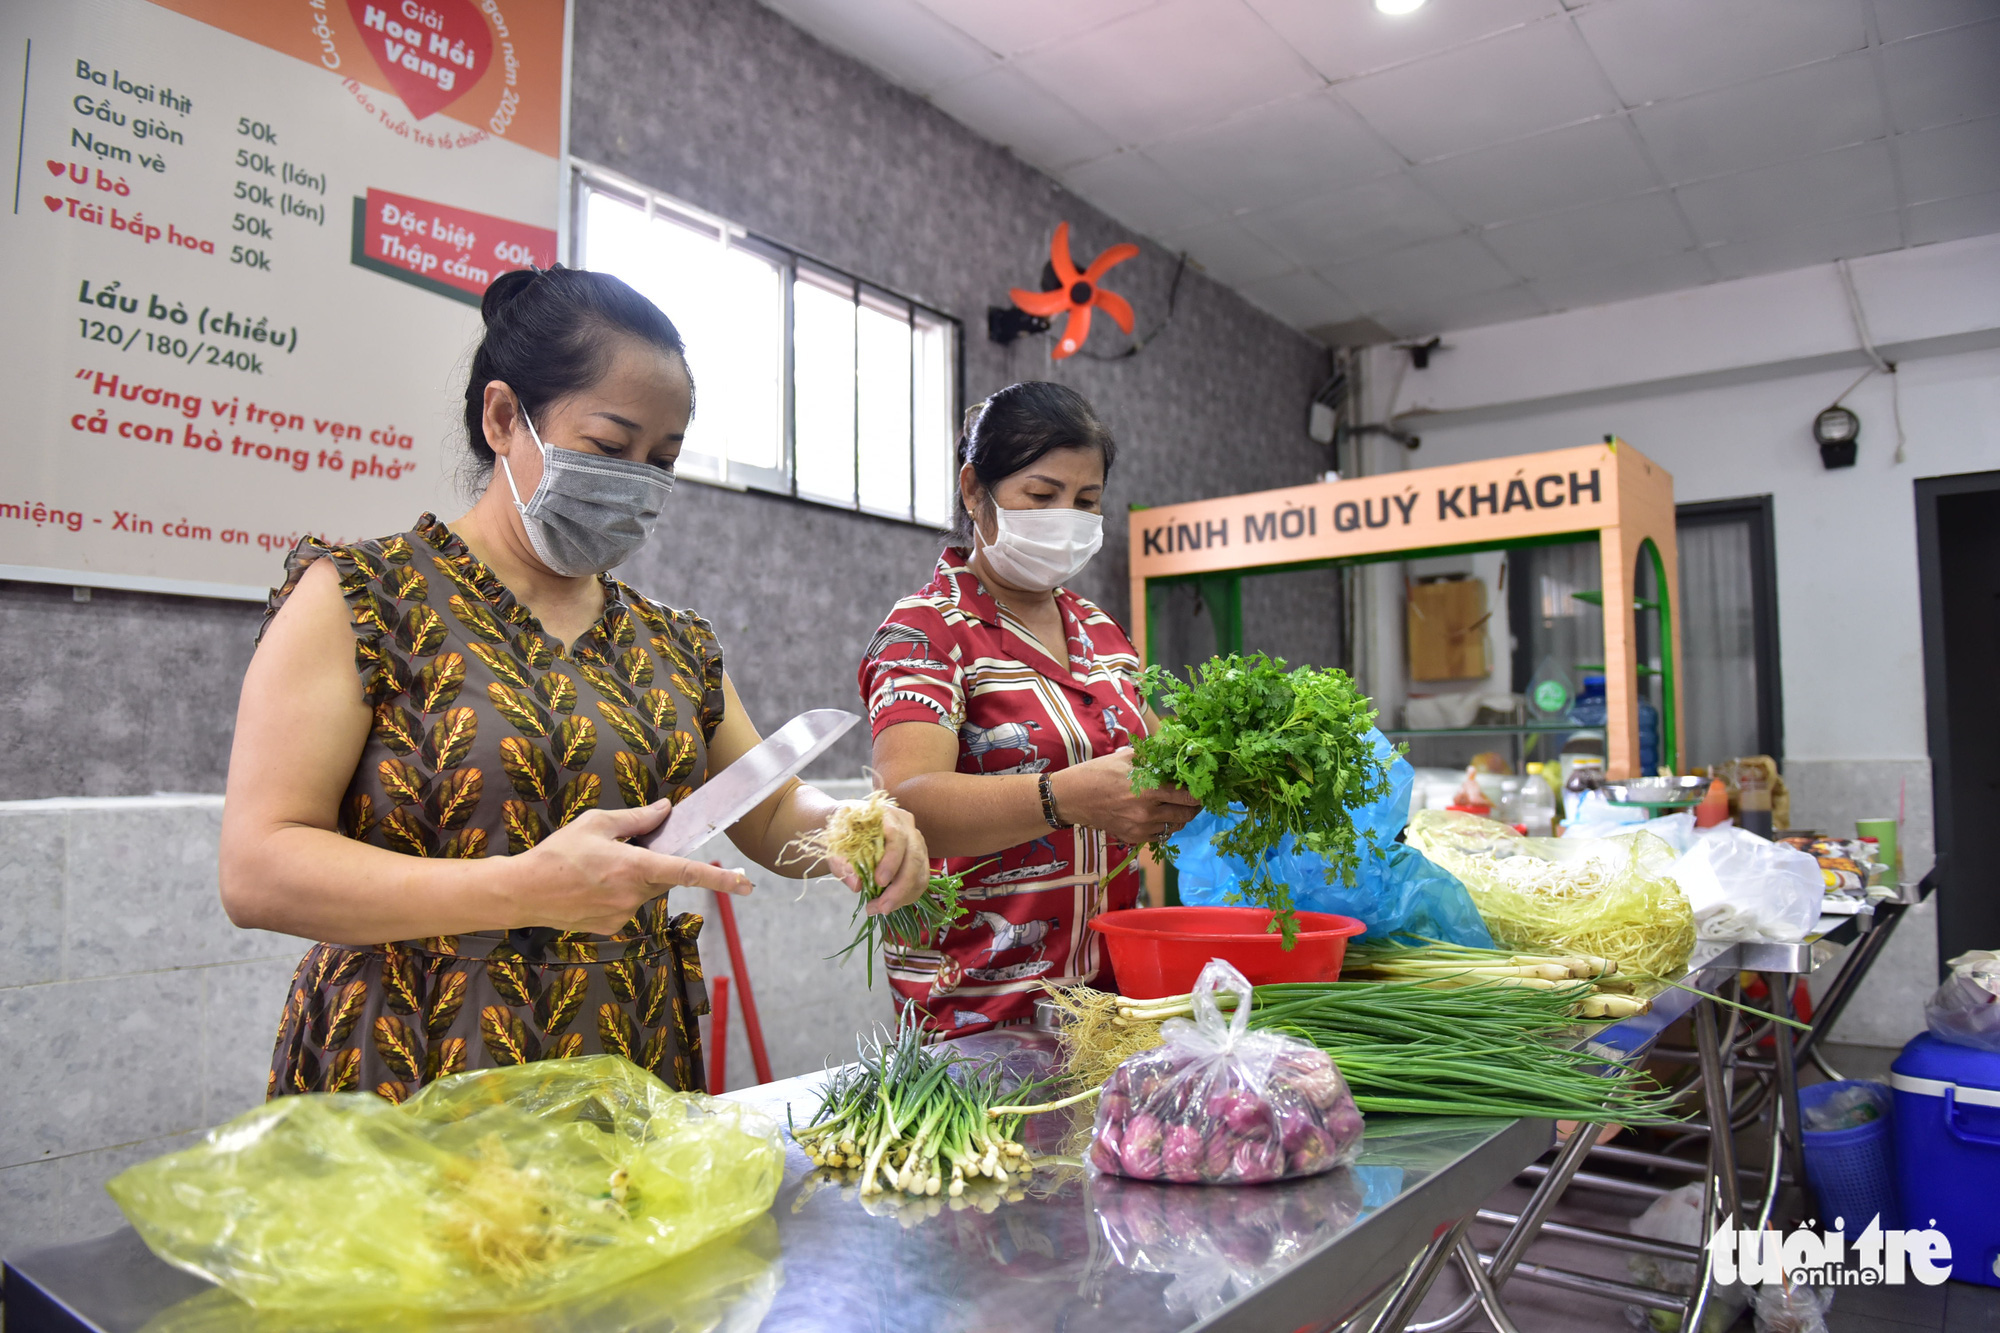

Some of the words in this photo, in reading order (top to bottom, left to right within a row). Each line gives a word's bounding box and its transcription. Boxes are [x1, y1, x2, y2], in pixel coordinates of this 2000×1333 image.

[312, 13, 340, 69] Cuộc
[363, 4, 423, 47] Hoa
[428, 31, 475, 70] Hồi
[401, 0, 444, 32] Giải
[384, 37, 456, 91] Vàng
[76, 58, 107, 87] Ba
[112, 68, 155, 104] loại
[159, 87, 193, 118] thịt
[237, 116, 278, 146] 50k
[489, 86, 519, 134] 2020
[71, 127, 132, 164] Nạm
[138, 152, 166, 174] vè
[234, 180, 275, 209] 50k
[280, 192, 325, 227] (lớn)
[73, 94, 126, 126] Gầu
[132, 118, 184, 146] giòn
[235, 148, 276, 177] 50k
[281, 161, 327, 196] (lớn)
[68, 162, 89, 185] U
[95, 168, 131, 197] bò
[232, 212, 274, 241] 50k
[65, 196, 104, 226] Tái
[109, 207, 162, 245] bắp
[167, 223, 215, 255] hoa
[230, 244, 272, 273] 50k
[380, 202, 428, 237] Đặc
[430, 216, 476, 253] biệt
[493, 240, 535, 268] 60k
[380, 233, 439, 275] Thập
[78, 279, 139, 314] Lẩu
[147, 293, 189, 326] bò
[199, 305, 298, 354] (chiều)
[78, 317, 266, 376] 120/180/240k
[70, 408, 109, 434] cả
[118, 421, 174, 445] con
[183, 423, 223, 453] bò
[231, 435, 310, 473] trong
[317, 449, 345, 472] tô
[211, 396, 239, 426] vị
[246, 402, 306, 434] trọn
[313, 418, 363, 444] vẹn
[370, 425, 414, 450] của
[0, 500, 84, 533] miệng
[111, 509, 154, 535] Xin
[162, 517, 212, 542] cảm
[220, 528, 250, 545] ơn
[1142, 516, 1229, 558] KÍNH
[1243, 500, 1317, 545] MỜI
[1332, 485, 1420, 533] QUÝ
[1437, 468, 1602, 521] KHÁCH
